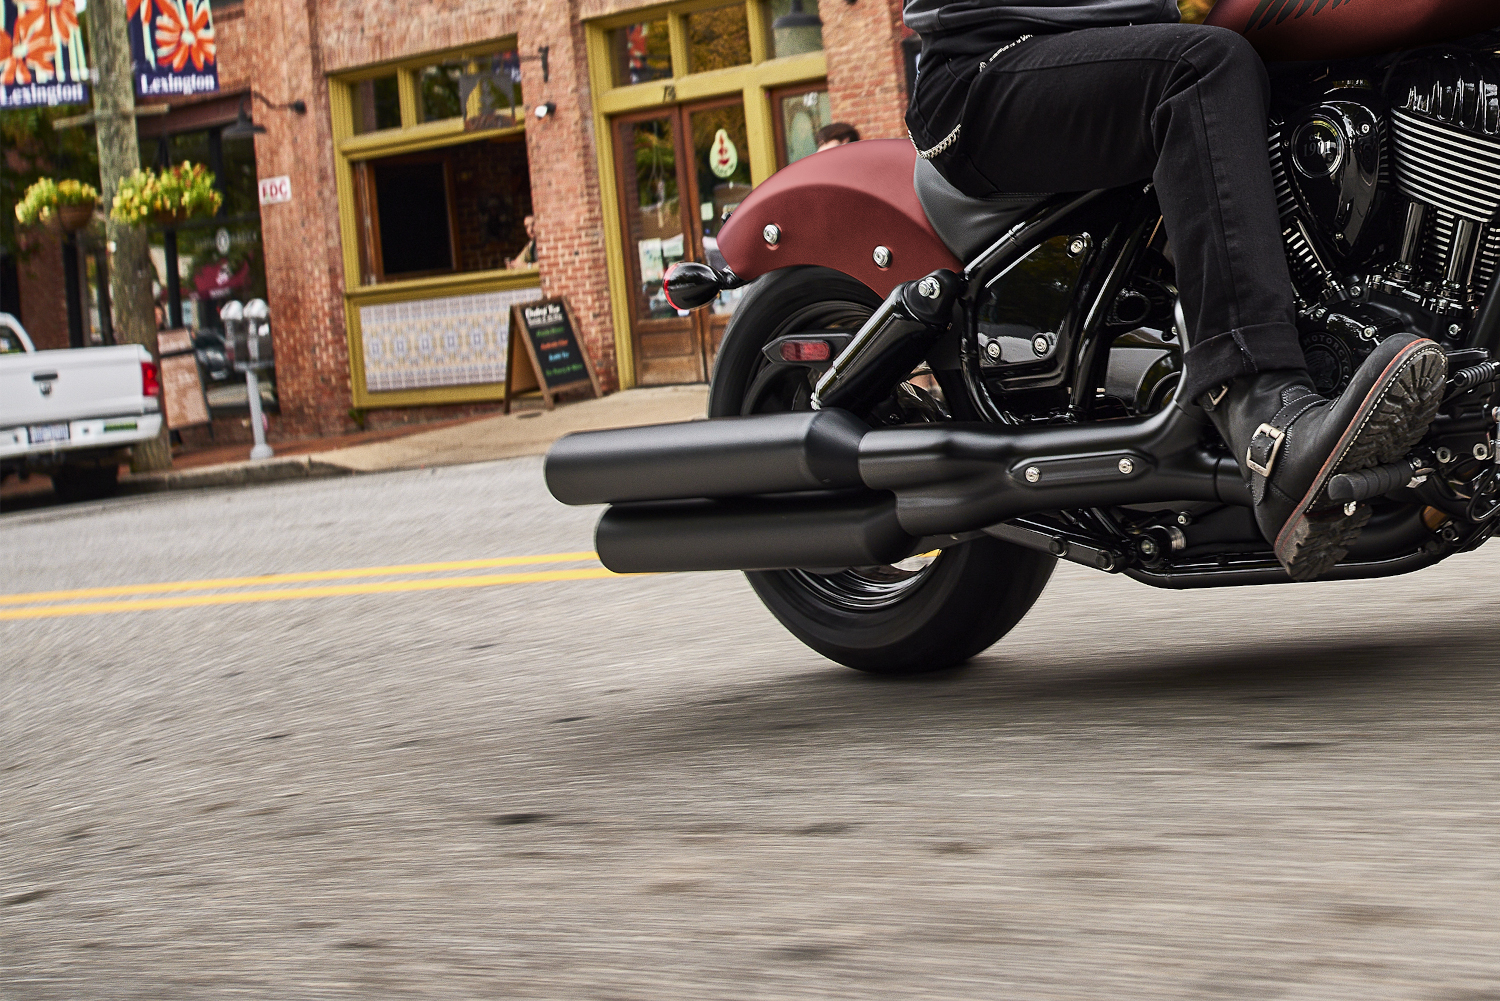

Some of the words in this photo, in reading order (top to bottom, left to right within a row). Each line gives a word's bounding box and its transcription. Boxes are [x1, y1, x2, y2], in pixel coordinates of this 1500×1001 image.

[0, 82, 83, 107] Lexington
[141, 73, 215, 96] Lexington
[1303, 140, 1331, 157] 1901
